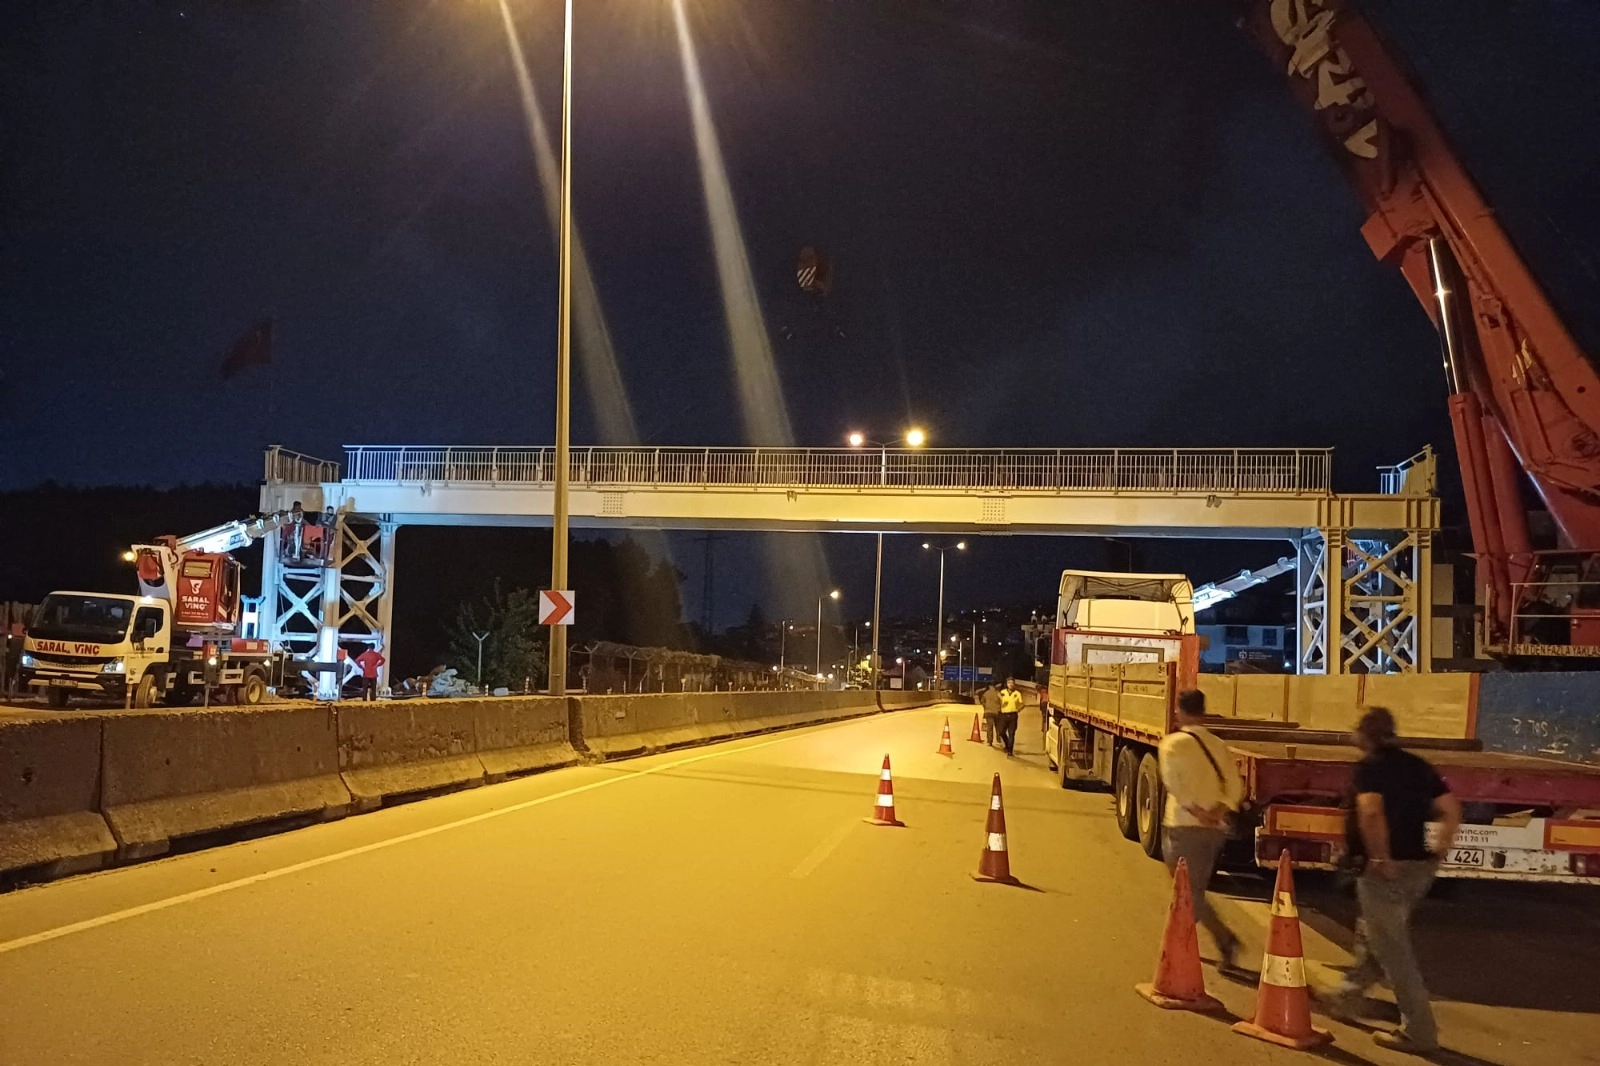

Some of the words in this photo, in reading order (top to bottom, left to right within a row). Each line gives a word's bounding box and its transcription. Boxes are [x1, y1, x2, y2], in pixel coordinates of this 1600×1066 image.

[181, 595, 210, 604] SARAL
[1547, 645, 1570, 656] FAZLA
[1454, 850, 1480, 864] 424
